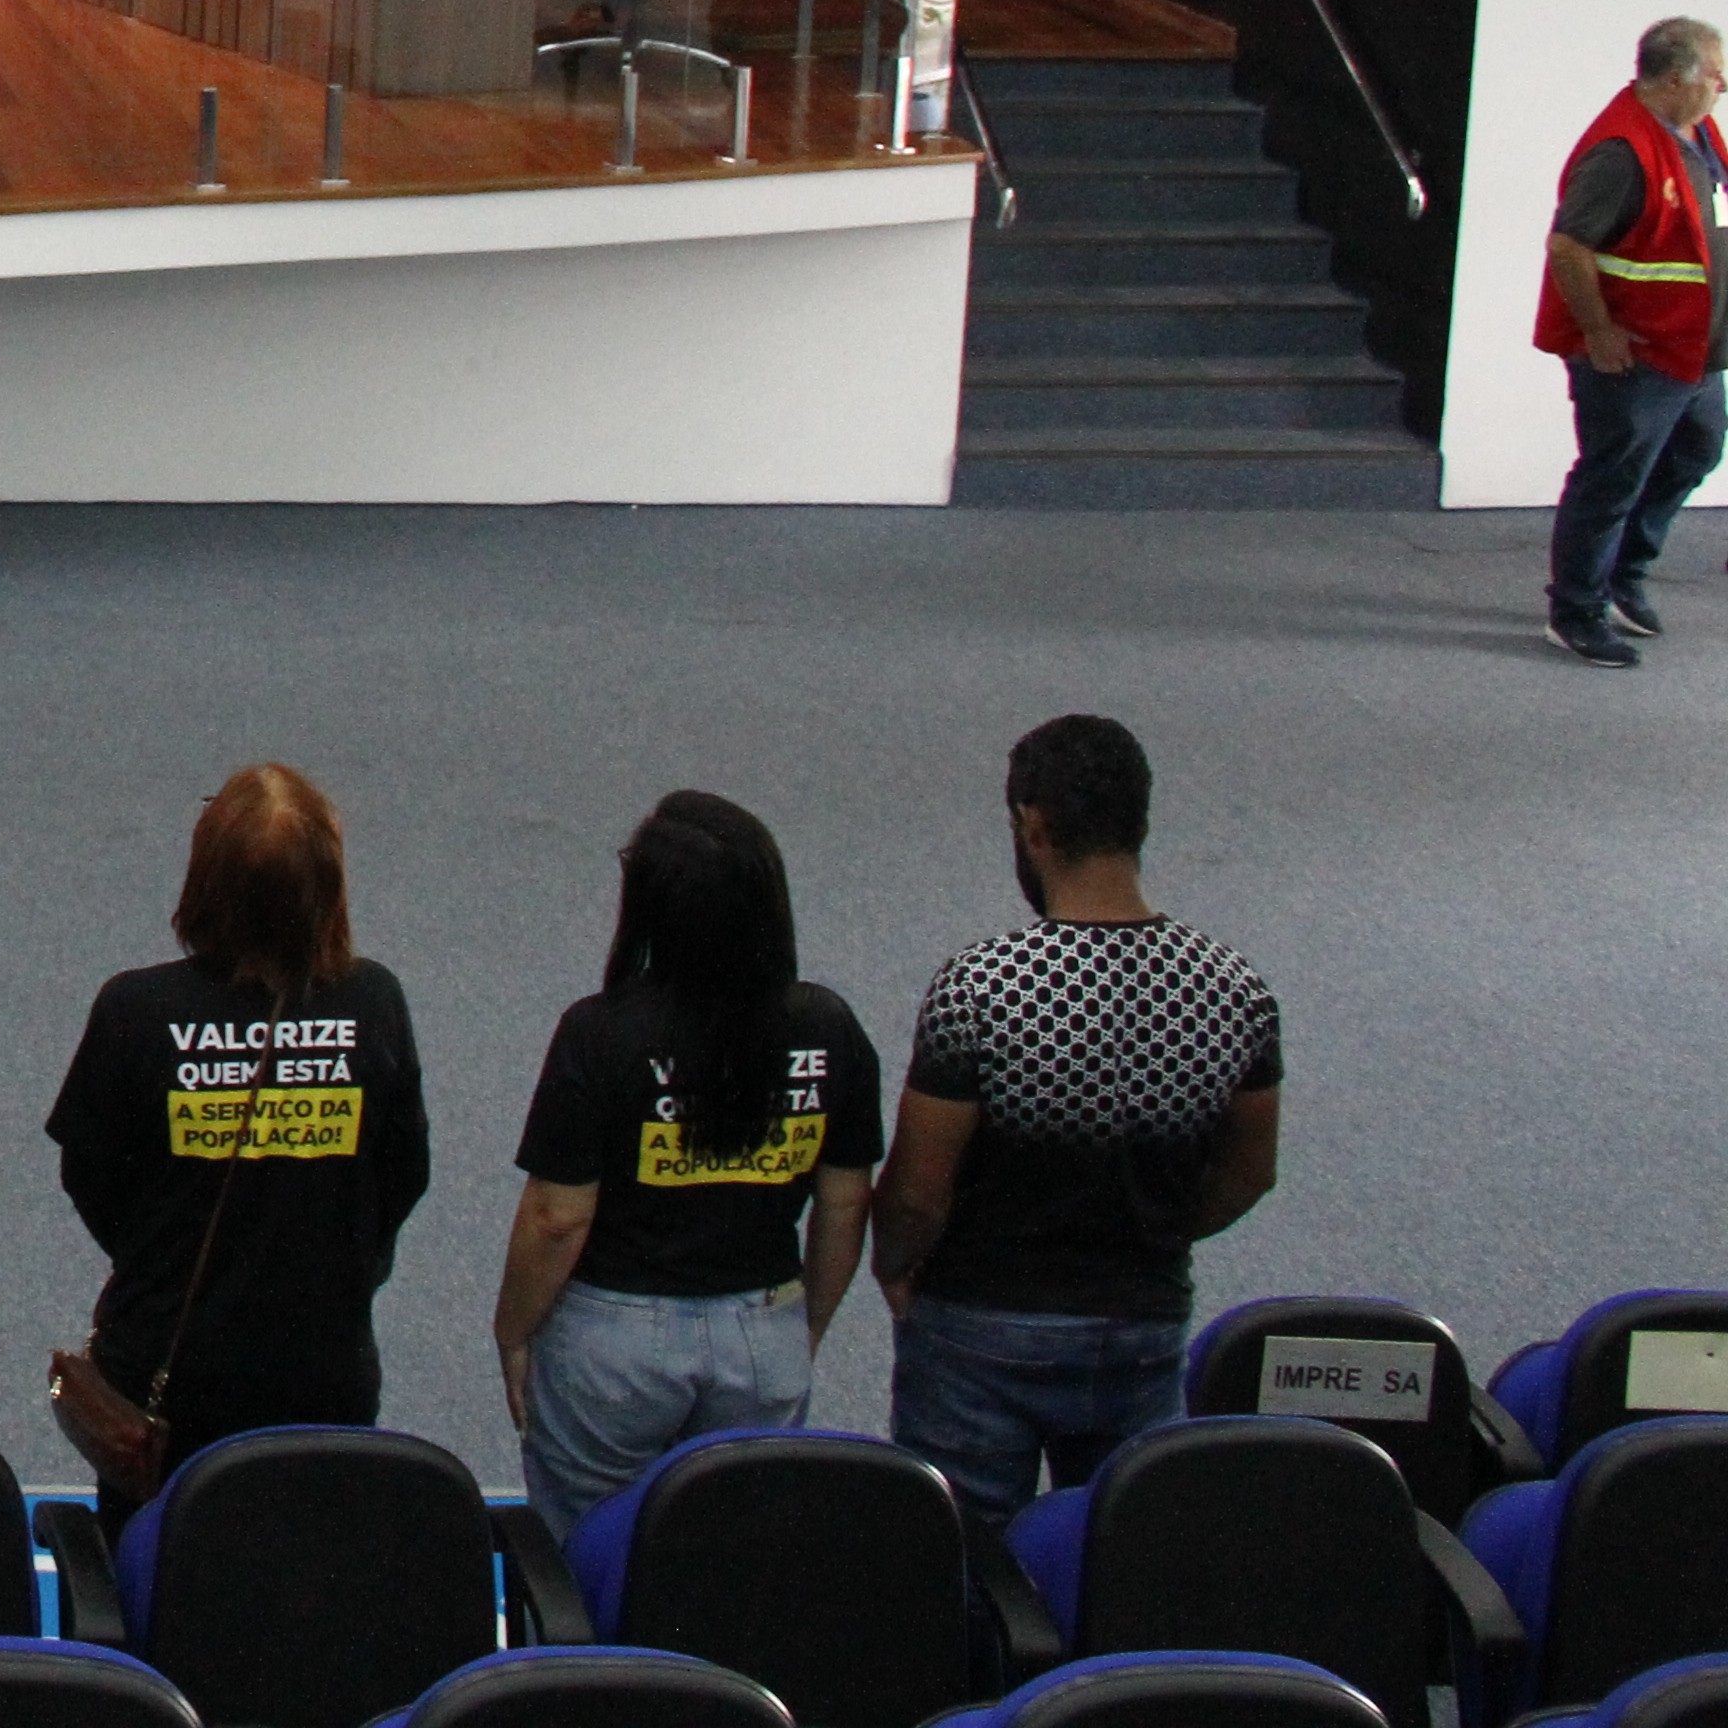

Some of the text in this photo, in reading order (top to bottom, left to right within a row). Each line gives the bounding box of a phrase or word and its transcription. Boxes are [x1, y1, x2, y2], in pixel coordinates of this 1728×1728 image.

[168, 1019, 357, 1051] VALORIZE
[276, 1053, 352, 1083] ESTÁ
[176, 1099, 353, 1121] A SERVIÇO DA
[184, 1123, 343, 1150] POPULAÇÃO!
[649, 1133, 669, 1150] A
